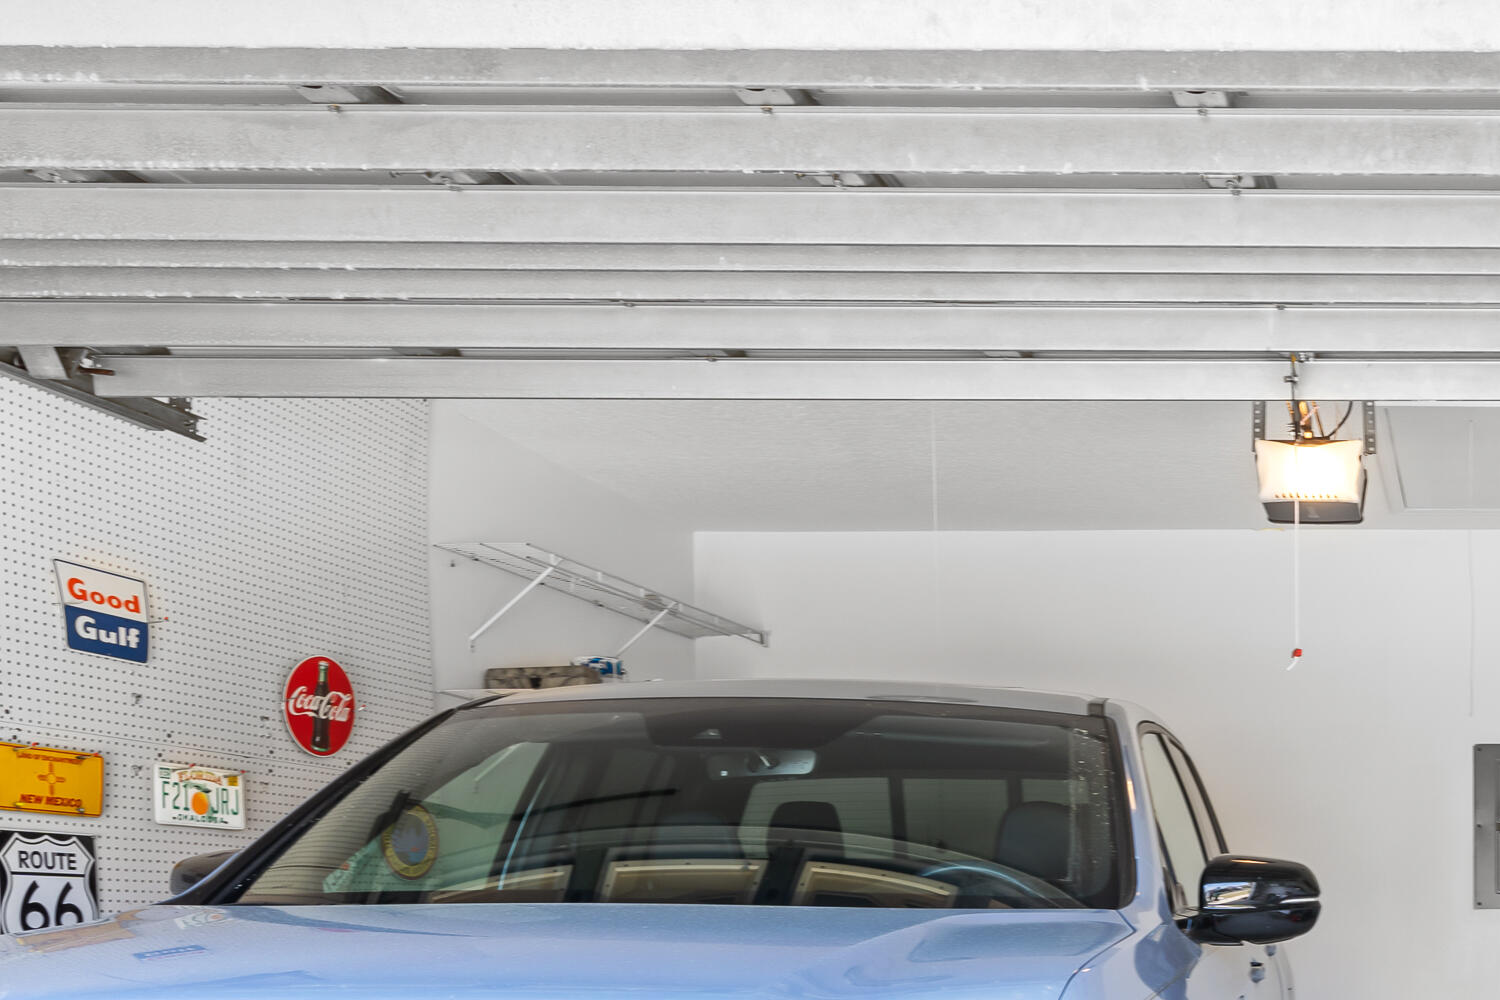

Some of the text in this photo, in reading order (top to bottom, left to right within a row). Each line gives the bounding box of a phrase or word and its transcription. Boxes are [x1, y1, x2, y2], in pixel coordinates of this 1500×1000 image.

[67, 577, 141, 614] Good
[74, 615, 140, 649] Gulf
[19, 794, 83, 808] NEW MEXICO
[18, 851, 77, 870] ROUTE
[20, 881, 84, 931] 66
